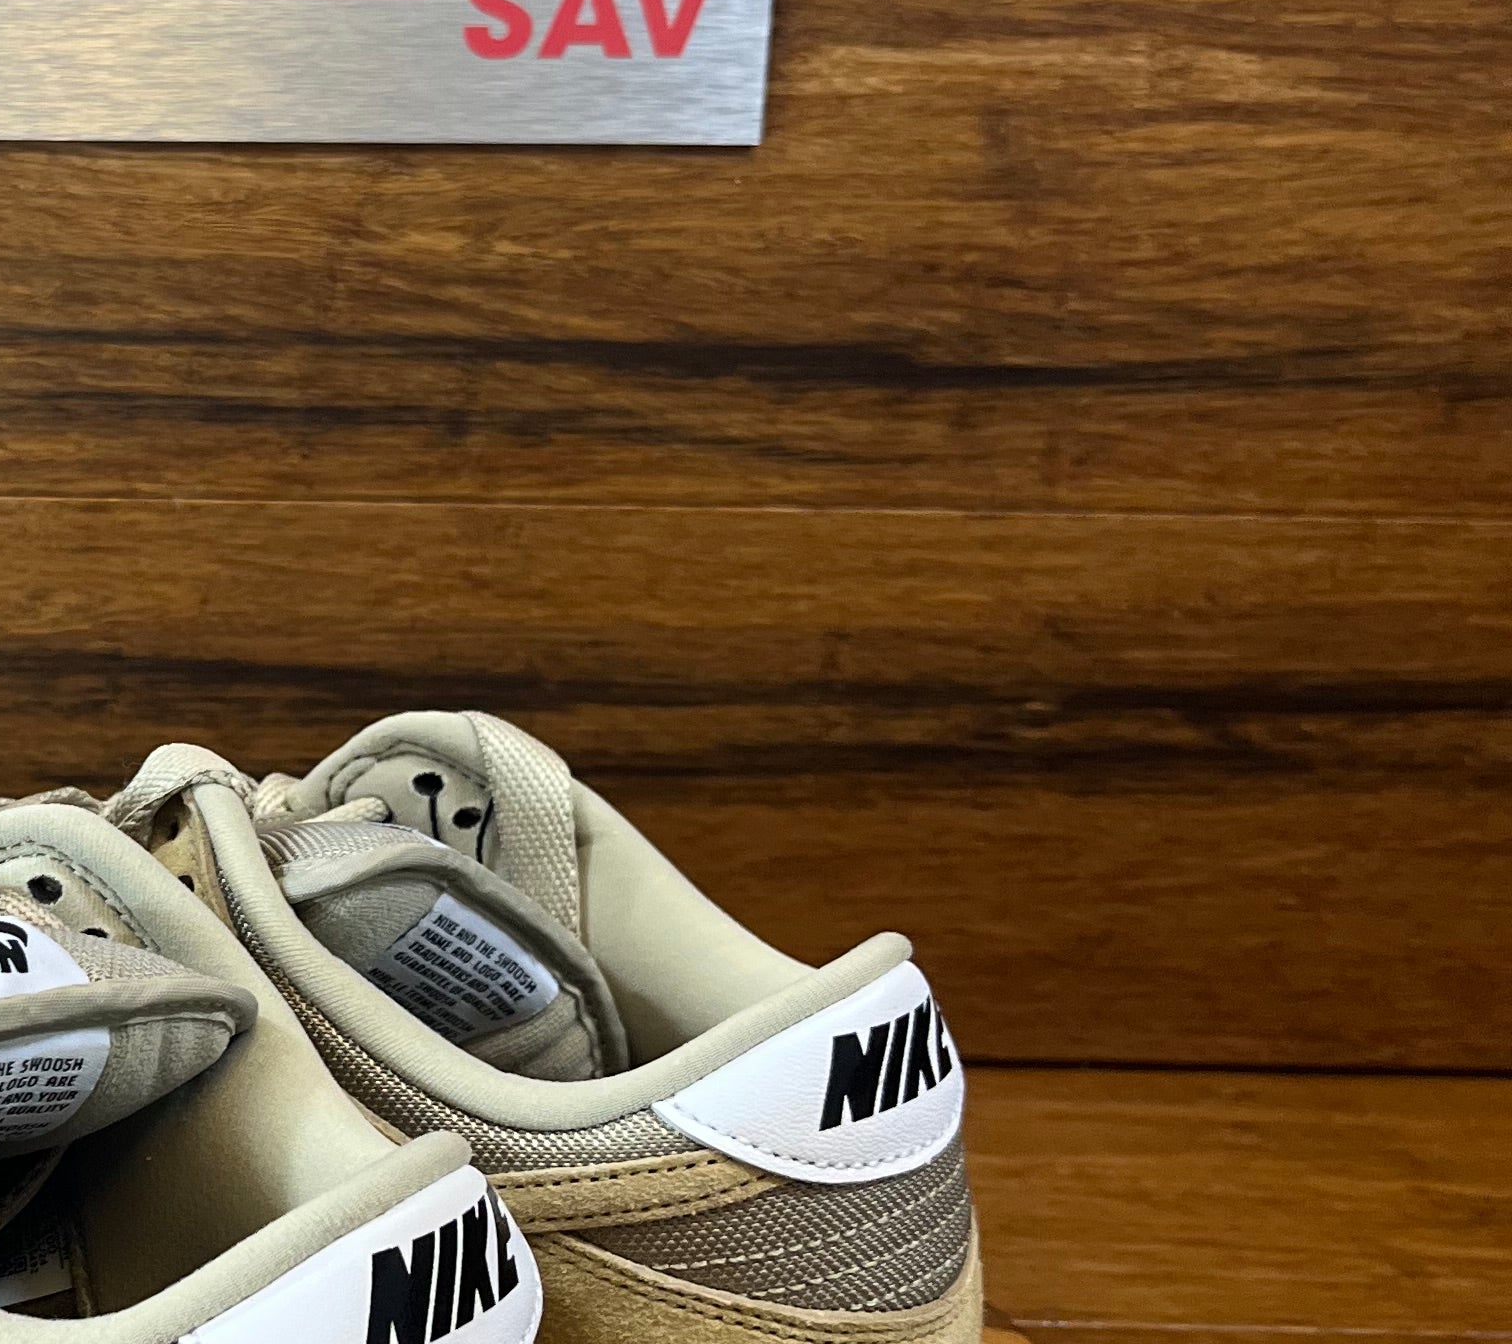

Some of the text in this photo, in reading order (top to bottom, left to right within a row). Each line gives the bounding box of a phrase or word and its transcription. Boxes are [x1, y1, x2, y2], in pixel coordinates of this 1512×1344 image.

[421, 928, 525, 1002] NAME AND LOGO ARE
[456, 928, 478, 946] AND
[476, 939, 497, 959] THE
[495, 953, 537, 994] SWOOSH
[19, 1058, 84, 1073] SWOOSH
[46, 1075, 78, 1087] ARE
[1, 1092, 33, 1105] AND
[38, 1090, 79, 1102] YOUR
[7, 1103, 71, 1115] QUALITY
